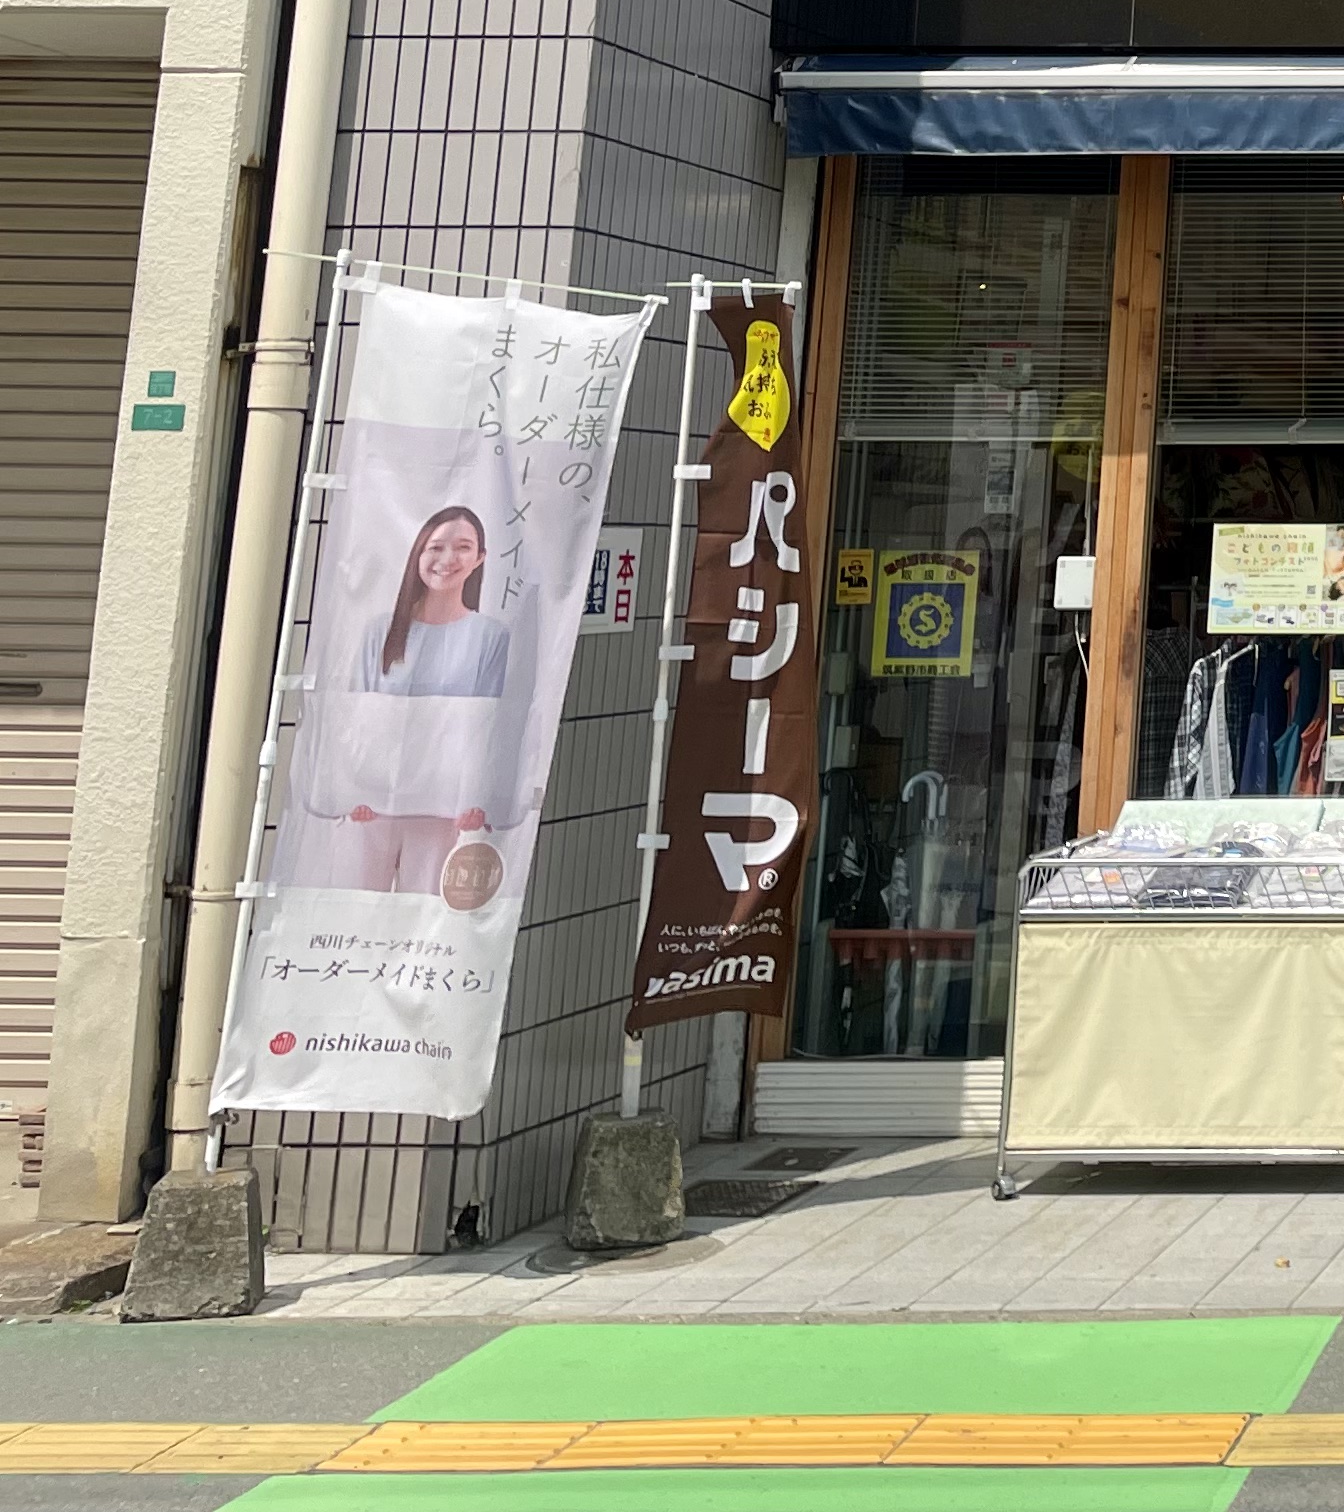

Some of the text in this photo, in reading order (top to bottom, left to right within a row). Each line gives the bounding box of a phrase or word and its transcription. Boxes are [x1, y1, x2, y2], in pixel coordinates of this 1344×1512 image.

[477, 324, 516, 456] まくら。
[559, 338, 621, 503] 私仕様の、
[501, 335, 571, 610] オーダーメイド
[614, 549, 636, 623] 本日
[702, 471, 801, 891] パシーマ
[304, 1033, 453, 1061] nishikawa chain
